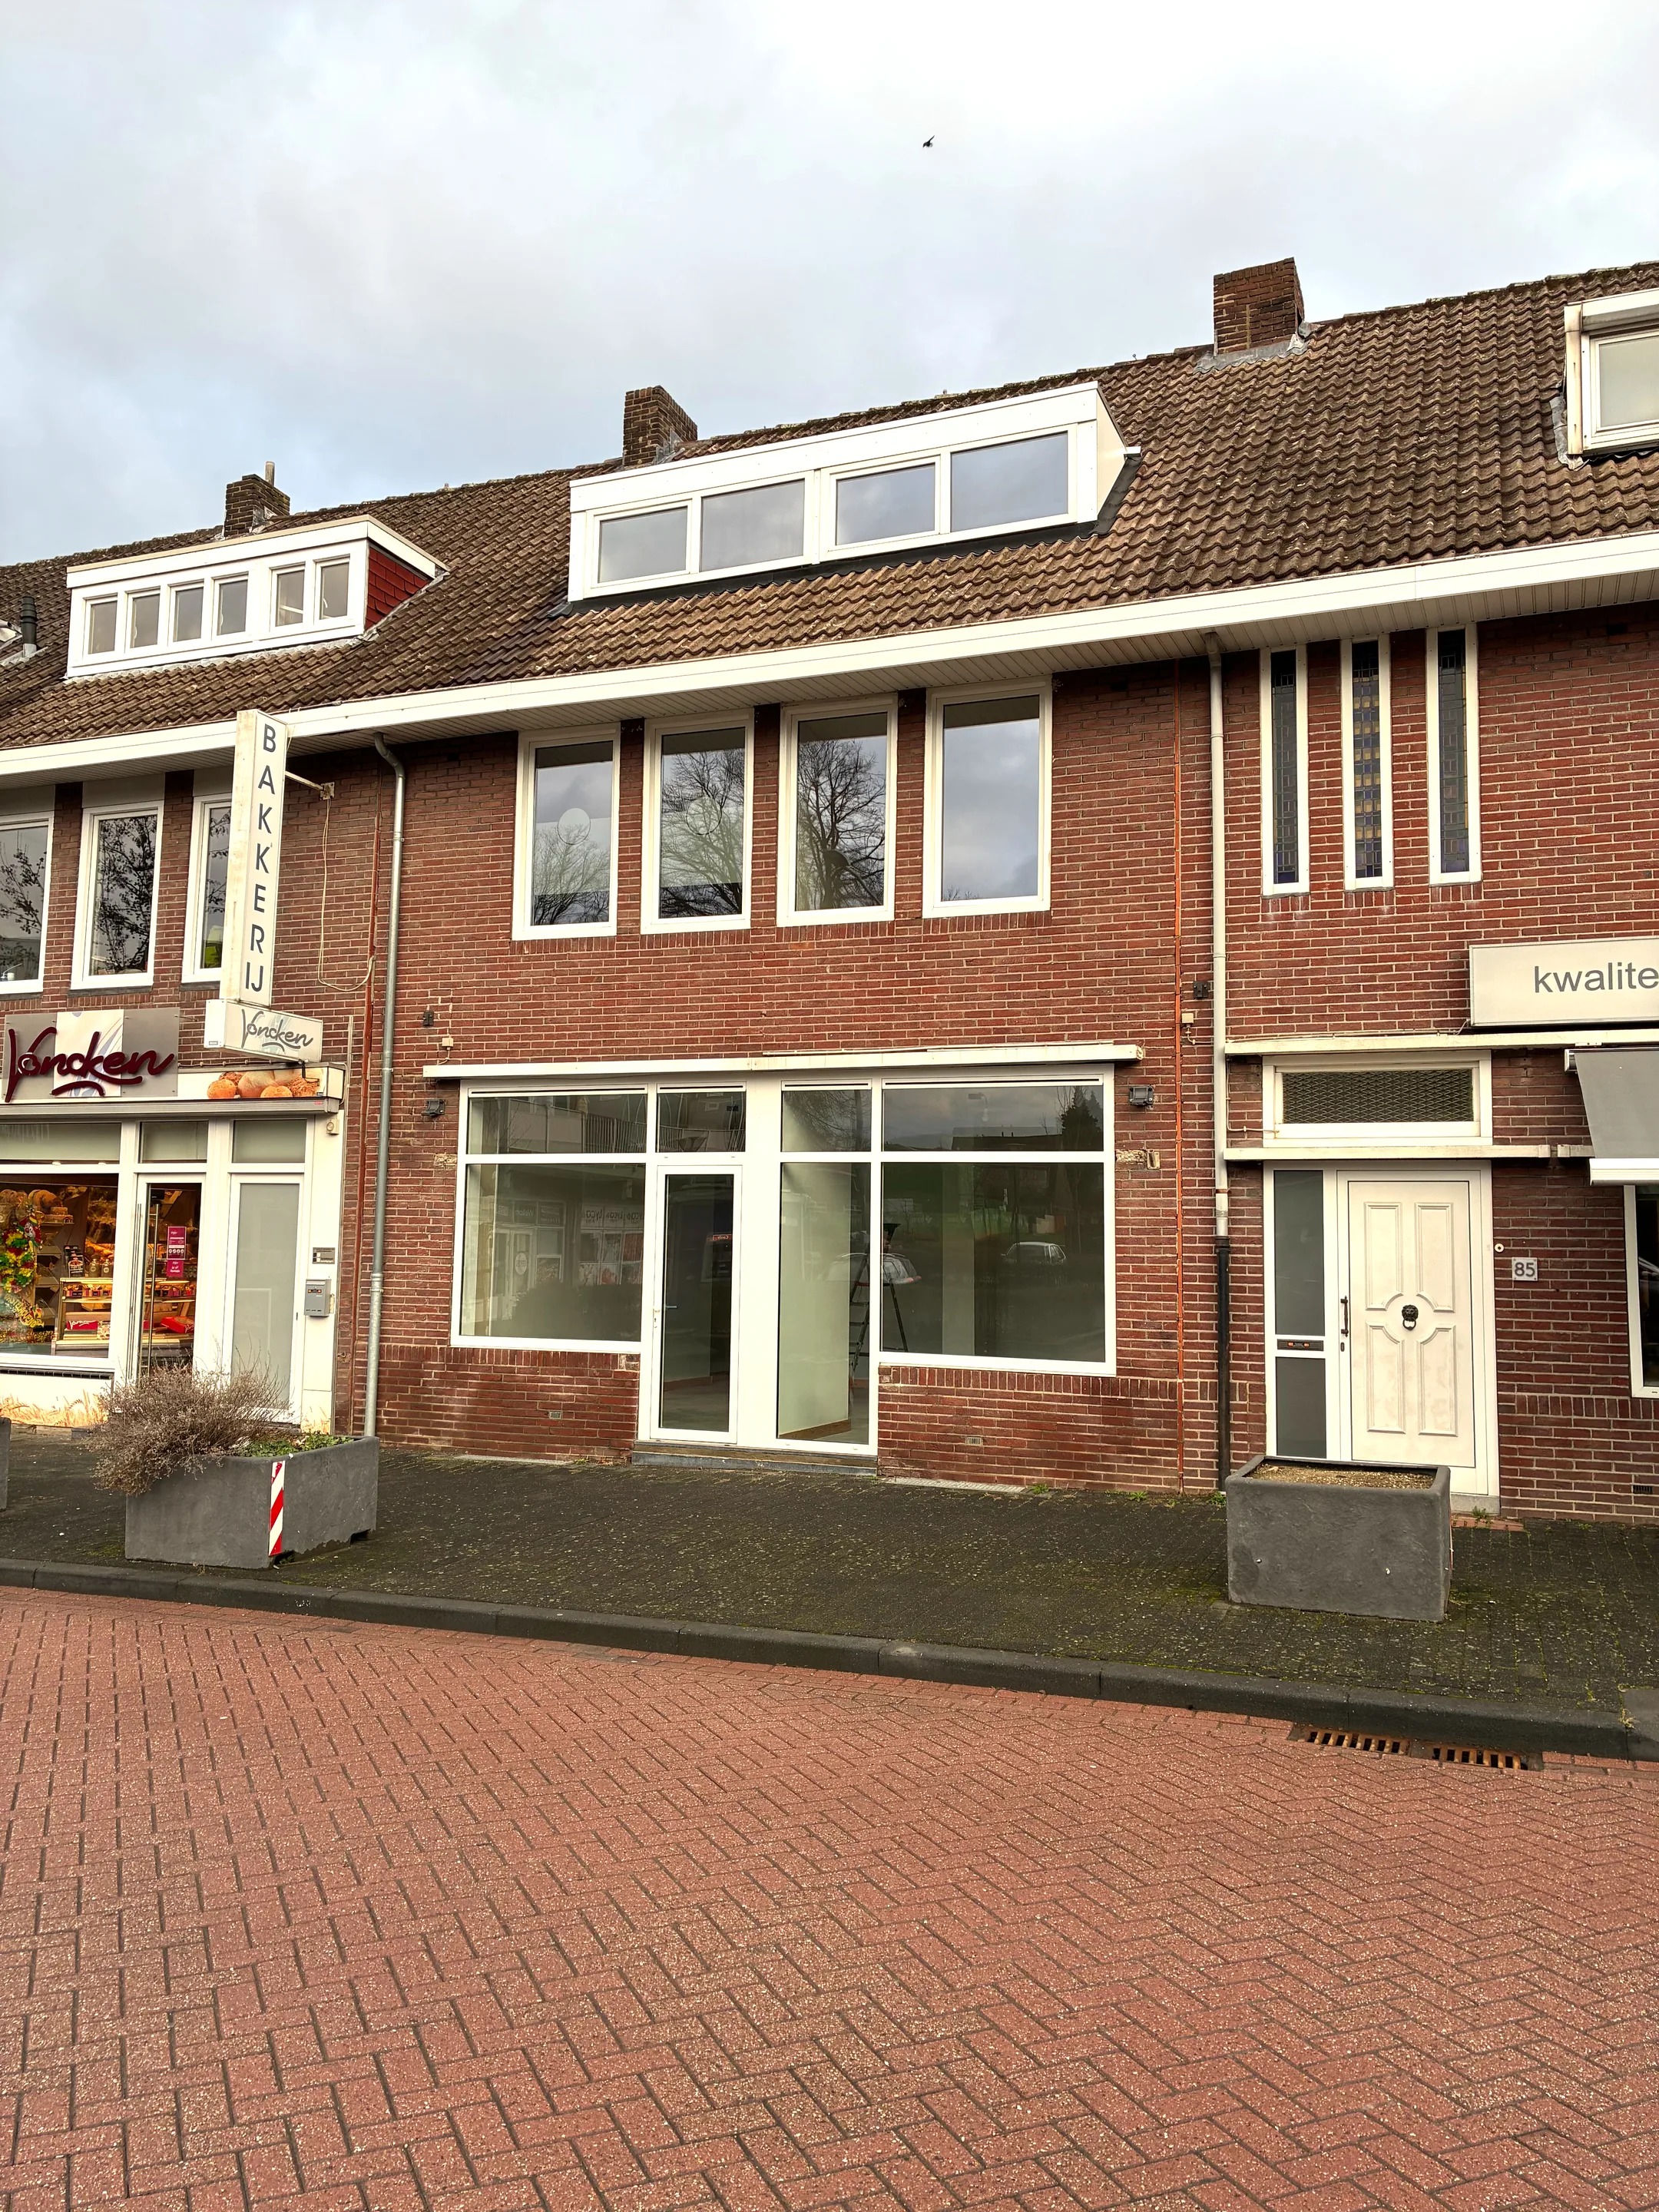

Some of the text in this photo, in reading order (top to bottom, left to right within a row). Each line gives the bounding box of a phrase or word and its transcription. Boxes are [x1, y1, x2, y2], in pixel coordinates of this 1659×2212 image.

[245, 723, 276, 992] BAKKERIJ
[1534, 962, 1659, 993] kwalite
[241, 1008, 313, 1051] Voncken
[5, 1027, 174, 1103] Voncken
[1515, 1262, 1535, 1277] 85
